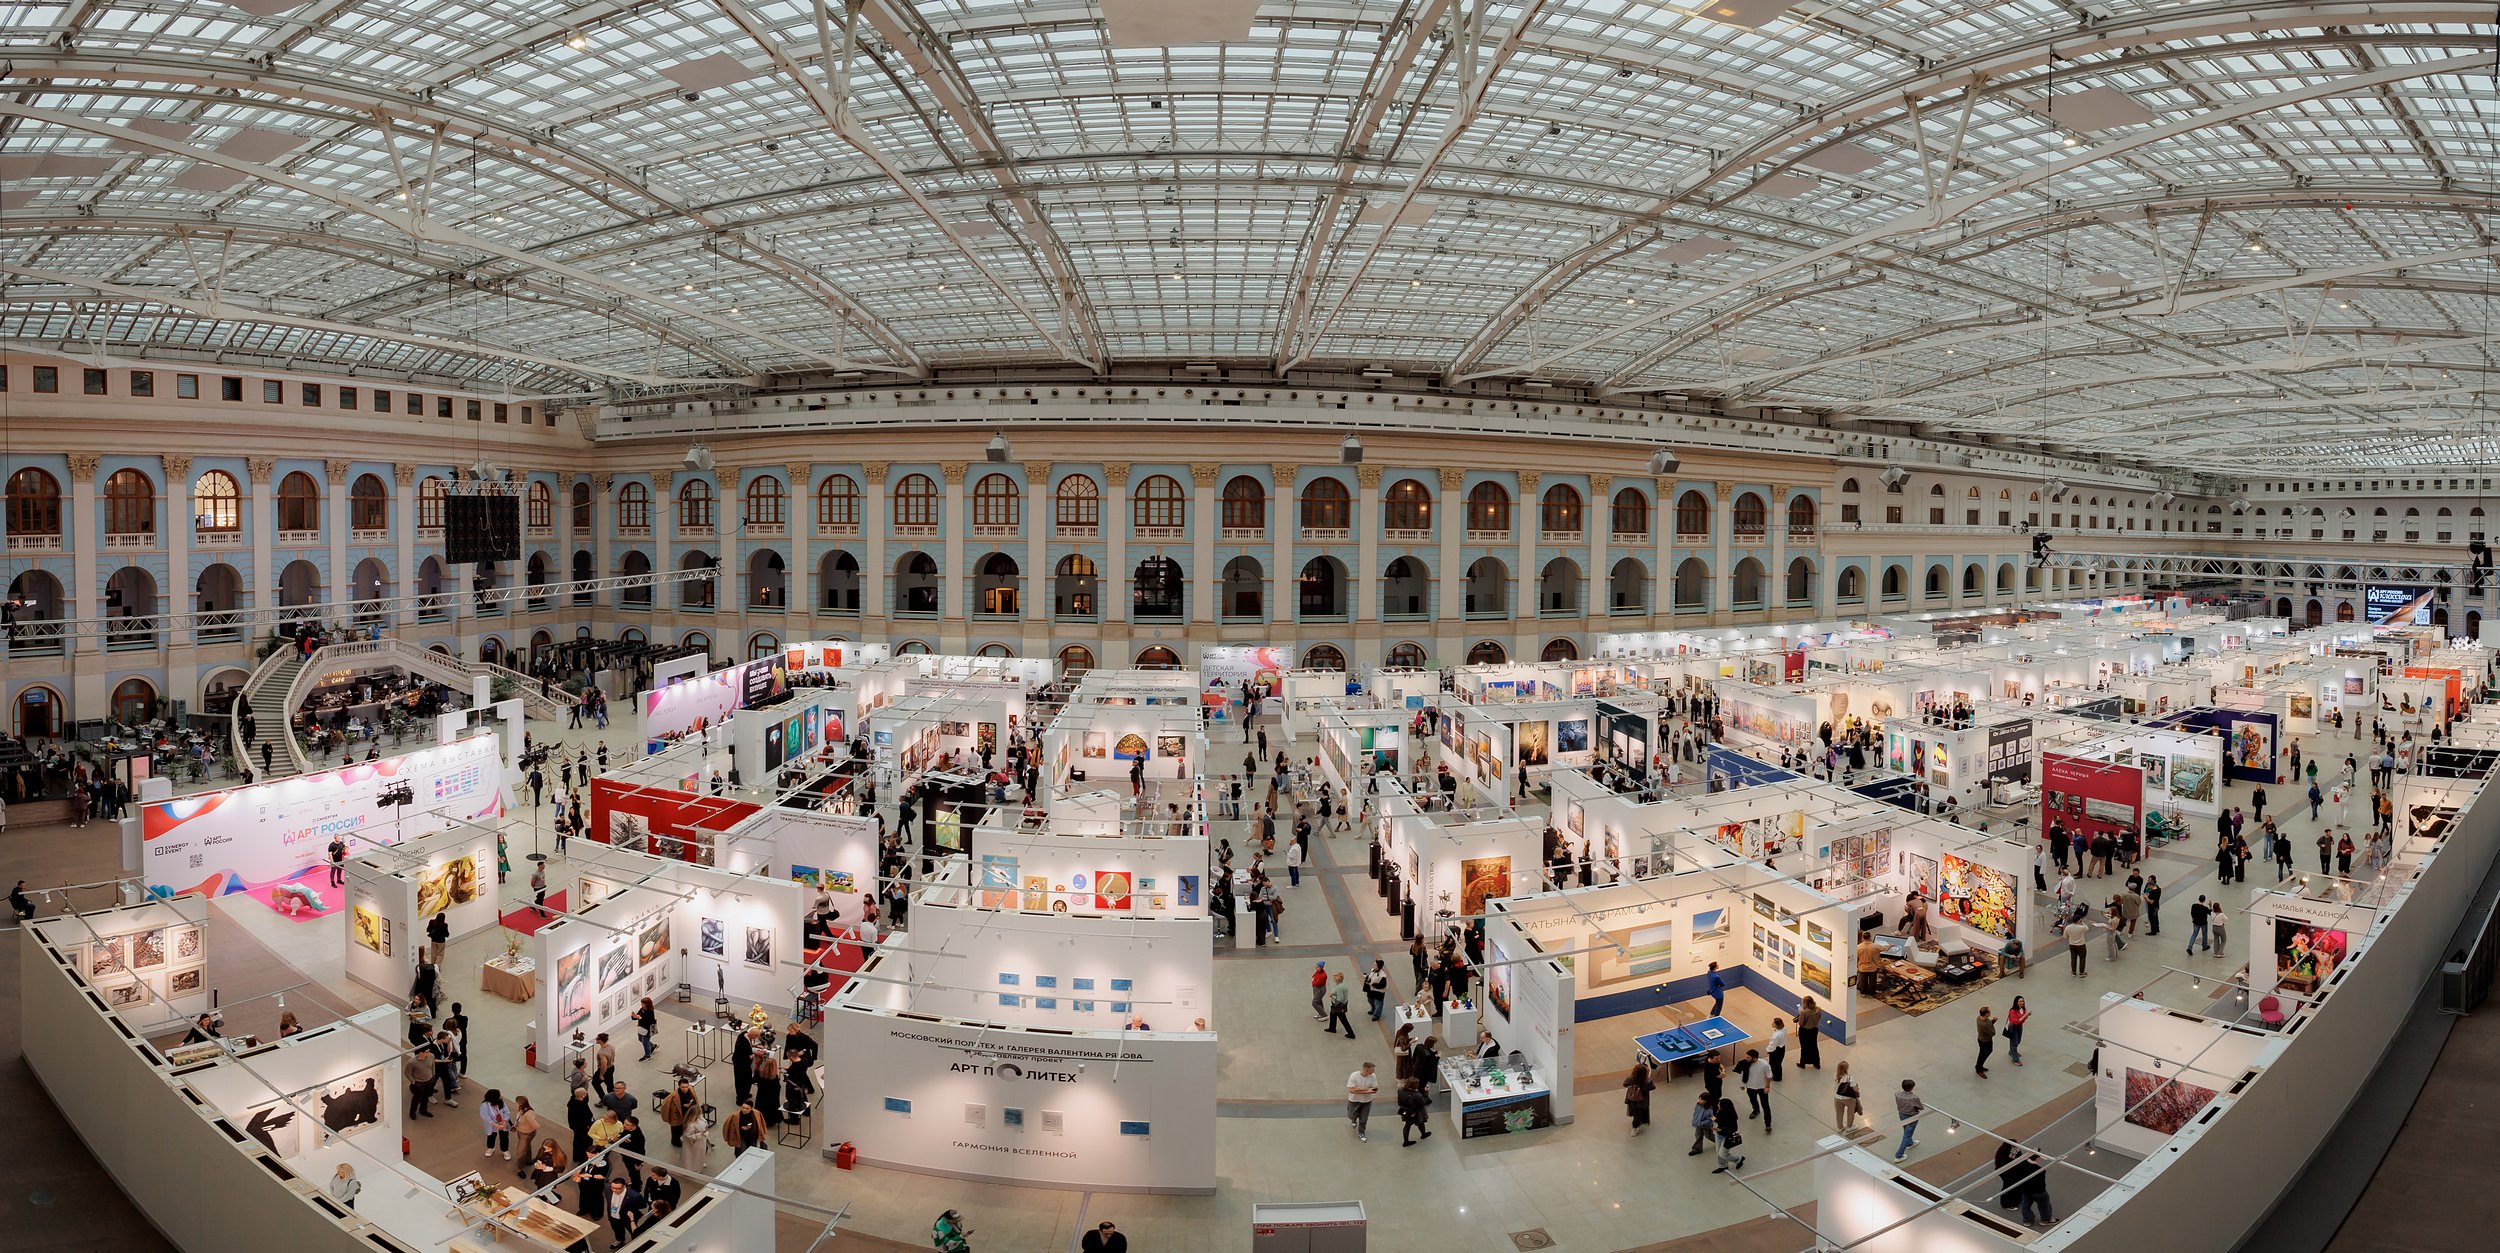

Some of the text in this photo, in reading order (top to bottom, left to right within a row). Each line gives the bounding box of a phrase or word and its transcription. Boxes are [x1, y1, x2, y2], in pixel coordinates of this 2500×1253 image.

[399, 745, 496, 776] СХЕМА ВЫСТАВКИ
[297, 815, 365, 840] АРТ РОССИЯ
[164, 842, 189, 851] SYNERGY
[1523, 903, 1654, 930] ТАТЬЯНА АБРАМОА
[2272, 903, 2350, 920] НАТАЛЬЯ ЖАДЕНОВА
[890, 1031, 953, 1045] МОСКОВСКИЙ
[955, 1040, 996, 1050] ПОЛТЕХ
[1007, 1045, 1046, 1054] ГАЛЕРЕЯ
[1047, 1048, 1103, 1058] ВАЛЕНТИНА
[950, 1062, 979, 1075] АРТ
[952, 1141, 1077, 1159] ГАРМОНИЯ ВСЕЛЕННОЙ
